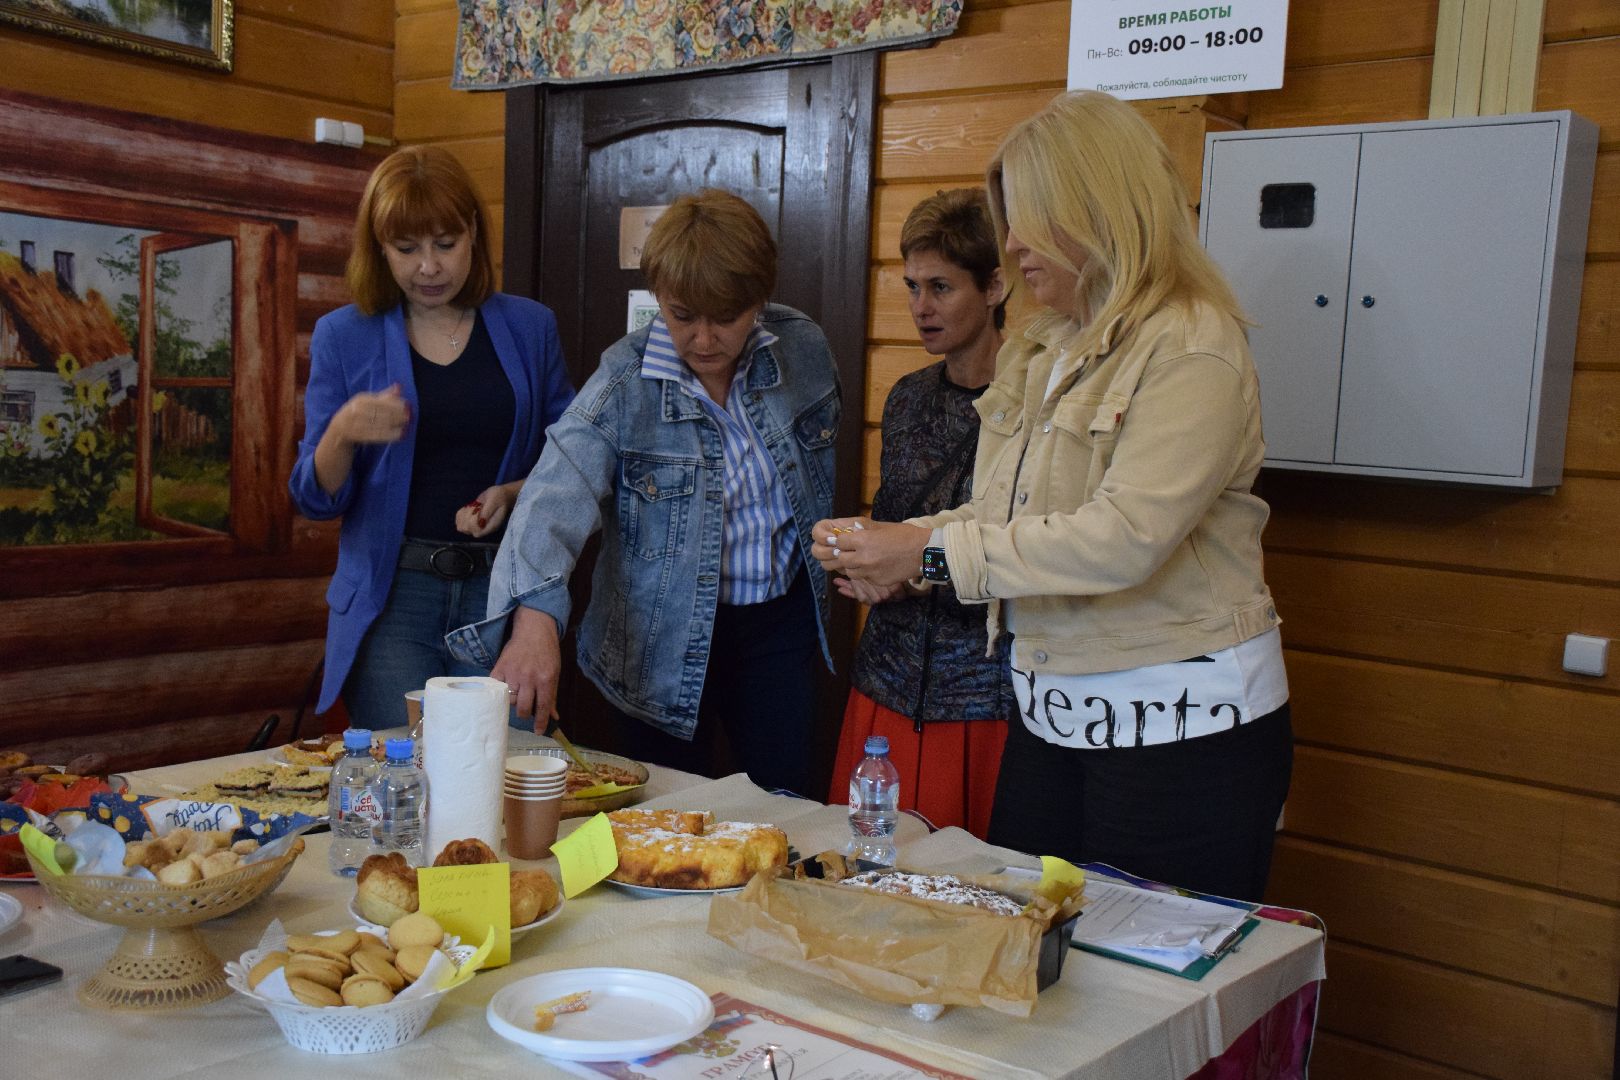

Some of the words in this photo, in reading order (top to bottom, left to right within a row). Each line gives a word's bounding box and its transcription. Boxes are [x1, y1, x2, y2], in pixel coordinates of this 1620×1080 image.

[1118, 13, 1167, 29] ВРЕМЯ
[1170, 5, 1232, 24] РАБОТЫ
[1087, 47, 1123, 60] Пн-Вс:
[1128, 34, 1186, 55] 09:00
[1205, 26, 1264, 48] 18:00
[1096, 80, 1151, 93] Пожалуйста,
[1152, 75, 1208, 88] соблюдайте
[1210, 73, 1248, 84] чистоту
